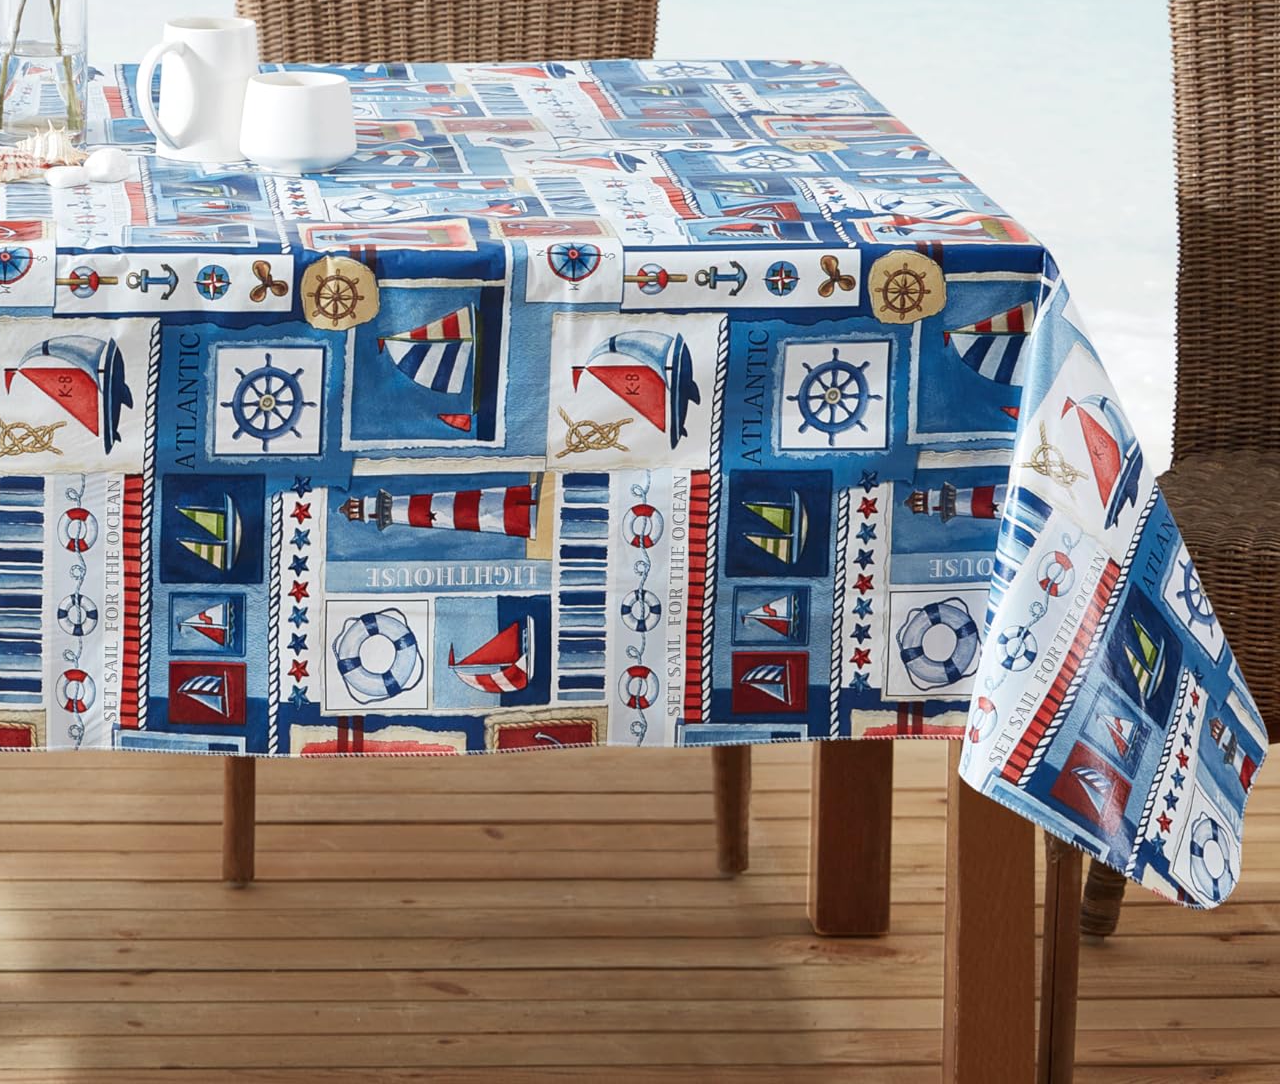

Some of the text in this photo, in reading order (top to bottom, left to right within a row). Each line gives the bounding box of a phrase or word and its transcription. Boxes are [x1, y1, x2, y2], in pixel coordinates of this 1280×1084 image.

[58, 375, 73, 398] K-8
[175, 332, 200, 471] ATLANTIC
[625, 373, 640, 396] K-8
[741, 329, 769, 467] ATLANTIC
[103, 480, 121, 722] SET SAIL FOR THE OCEAN
[365, 565, 538, 588] LIGHTHOUSE
[667, 475, 688, 717] SET SAIL FOR THE OCEAN
[1142, 510, 1179, 596] ATLAN
[988, 551, 1106, 766] SET SAIL FOR THE OCEAN
